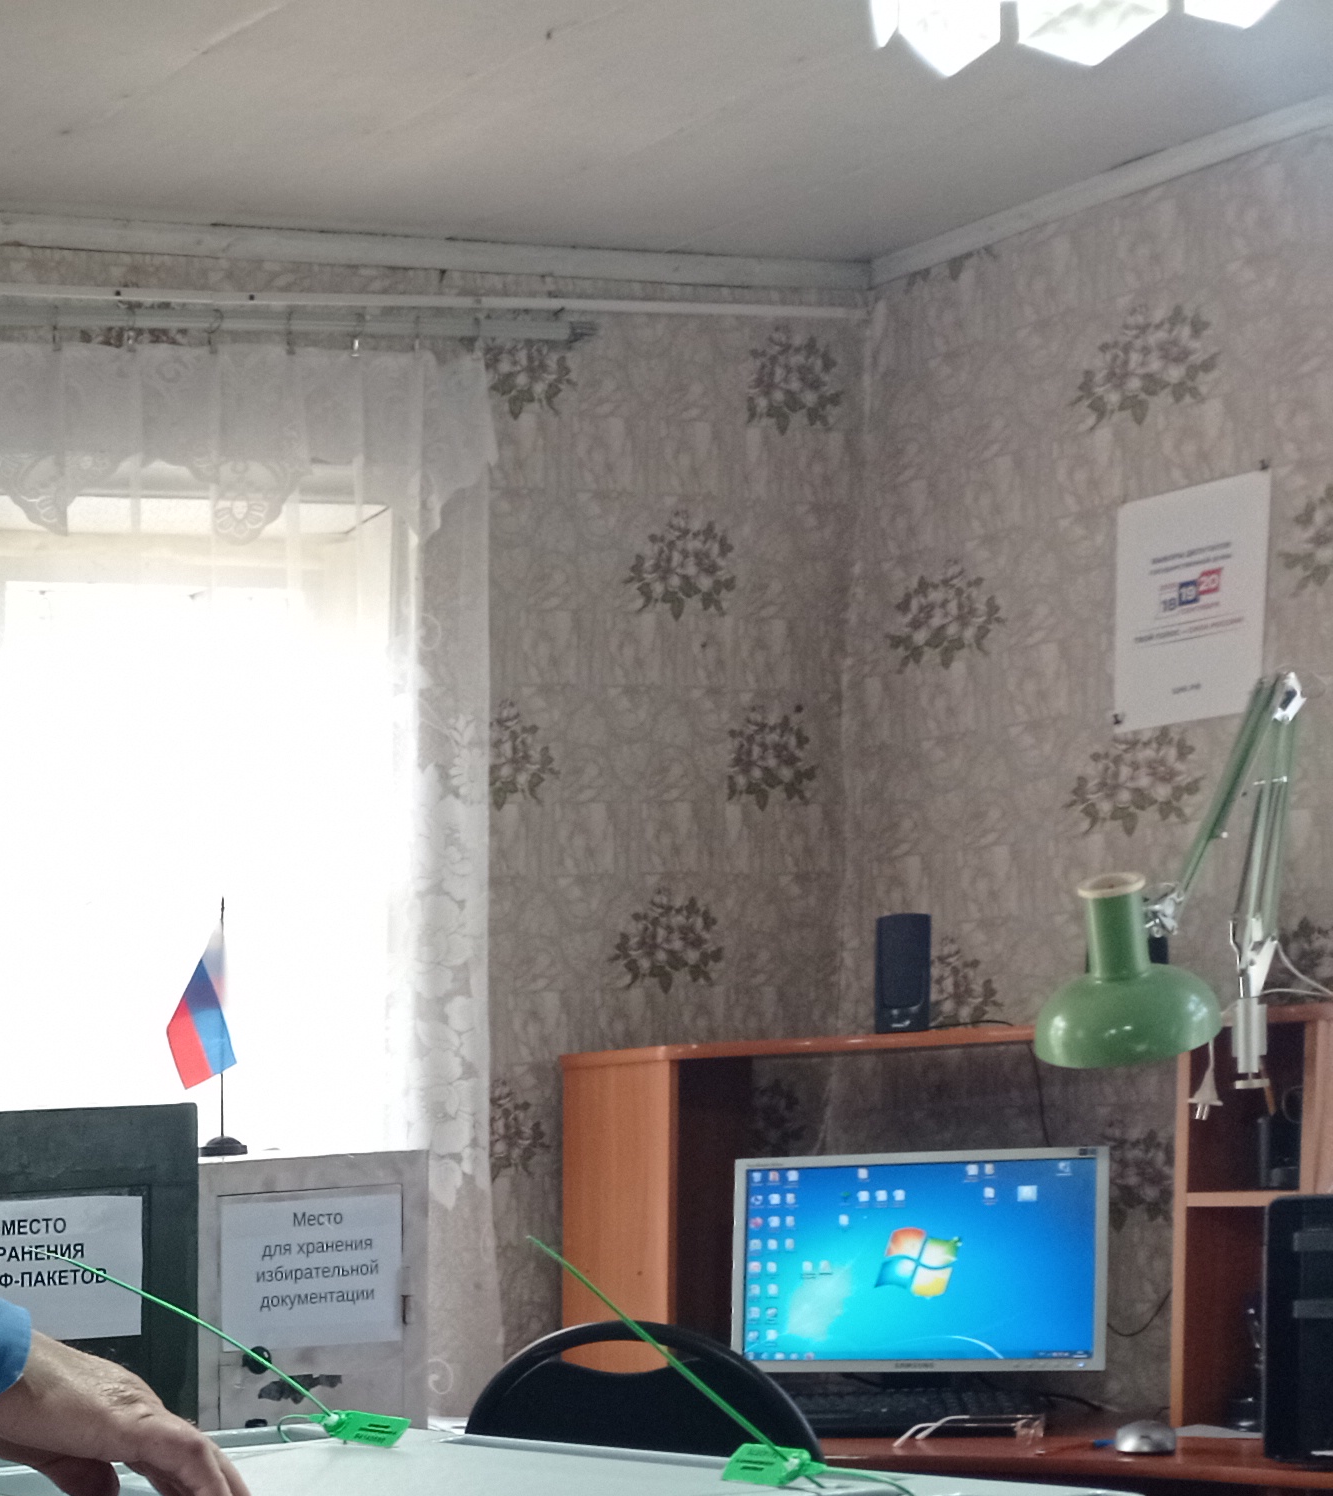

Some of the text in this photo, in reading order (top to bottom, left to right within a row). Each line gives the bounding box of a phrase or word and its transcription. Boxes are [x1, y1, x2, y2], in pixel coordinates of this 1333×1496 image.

[1, 1217, 67, 1236] МЕСТО
[292, 1211, 343, 1228] Место
[261, 1237, 373, 1261] для хранения
[256, 1259, 379, 1284] избирательной
[259, 1288, 375, 1312] документации
